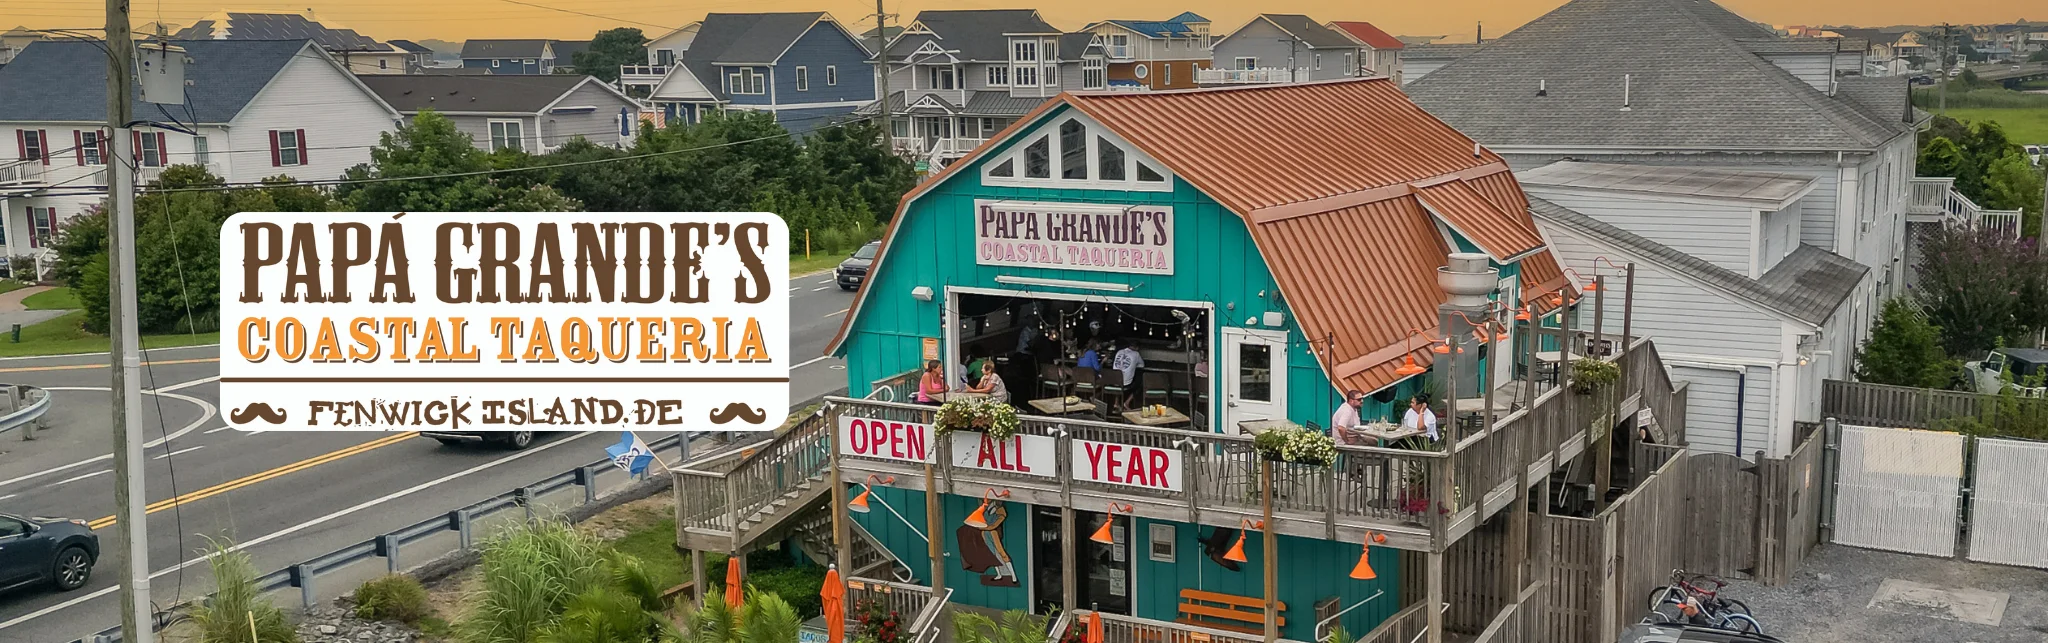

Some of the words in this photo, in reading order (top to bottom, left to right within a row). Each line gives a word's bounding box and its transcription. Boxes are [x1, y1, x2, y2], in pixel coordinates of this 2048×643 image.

[1046, 210, 1168, 246] GRANDE'S
[980, 241, 1064, 264] COASTAL
[1066, 245, 1169, 269] TAQUERIA
[849, 418, 926, 461] OPEN
[976, 432, 1031, 473] ALL
[1084, 441, 1170, 489] YEAR
